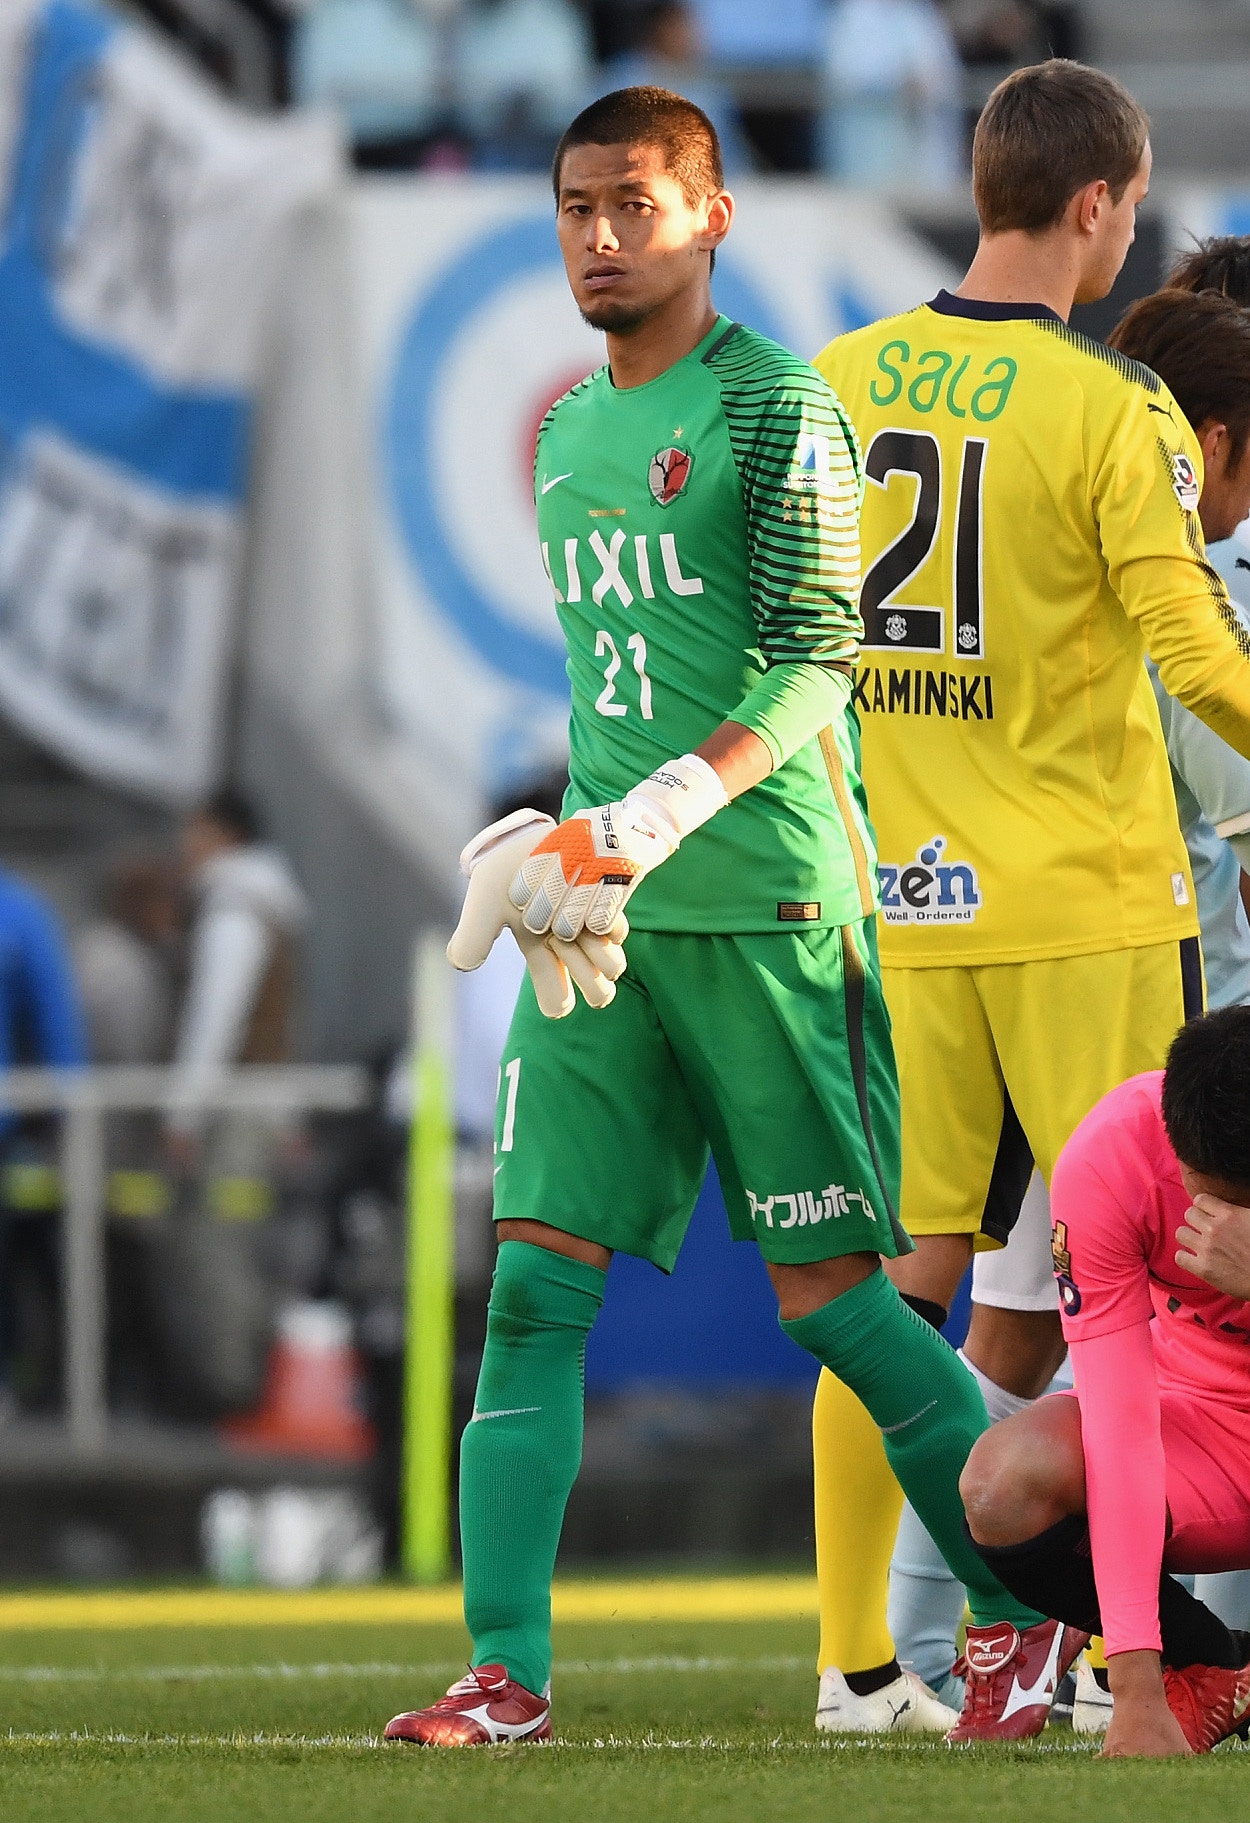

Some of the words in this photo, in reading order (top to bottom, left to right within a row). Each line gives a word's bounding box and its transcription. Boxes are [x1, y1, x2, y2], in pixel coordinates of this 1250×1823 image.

[869, 340, 1018, 422] sala
[541, 528, 705, 609] LIXIL
[860, 427, 990, 660] 21
[594, 630, 654, 720] 21
[852, 667, 994, 721] KAMINSKI
[877, 865, 979, 909] zen
[494, 1057, 522, 1155] 1
